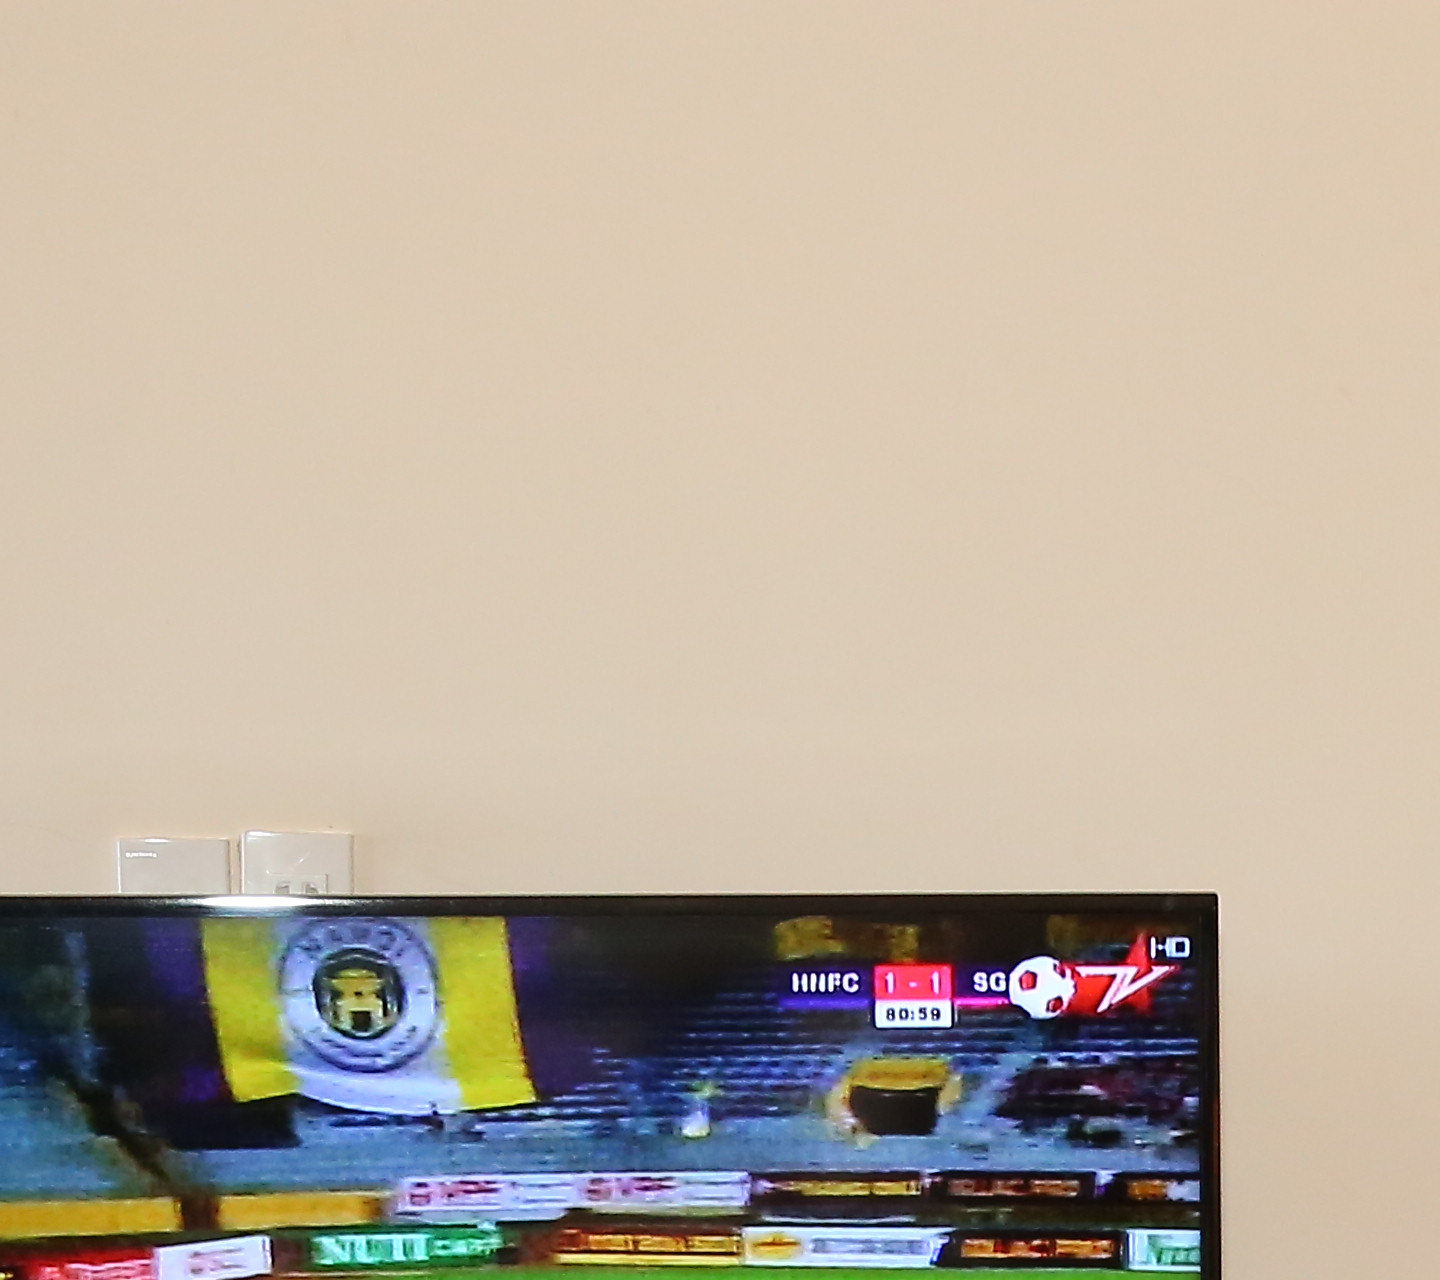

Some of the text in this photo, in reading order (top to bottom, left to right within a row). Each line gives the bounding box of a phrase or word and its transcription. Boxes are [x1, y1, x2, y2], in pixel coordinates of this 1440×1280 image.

[1151, 936, 1190, 959] HD
[885, 972, 895, 994] 1
[930, 971, 941, 995] 1
[886, 1007, 942, 1021] 80:59
